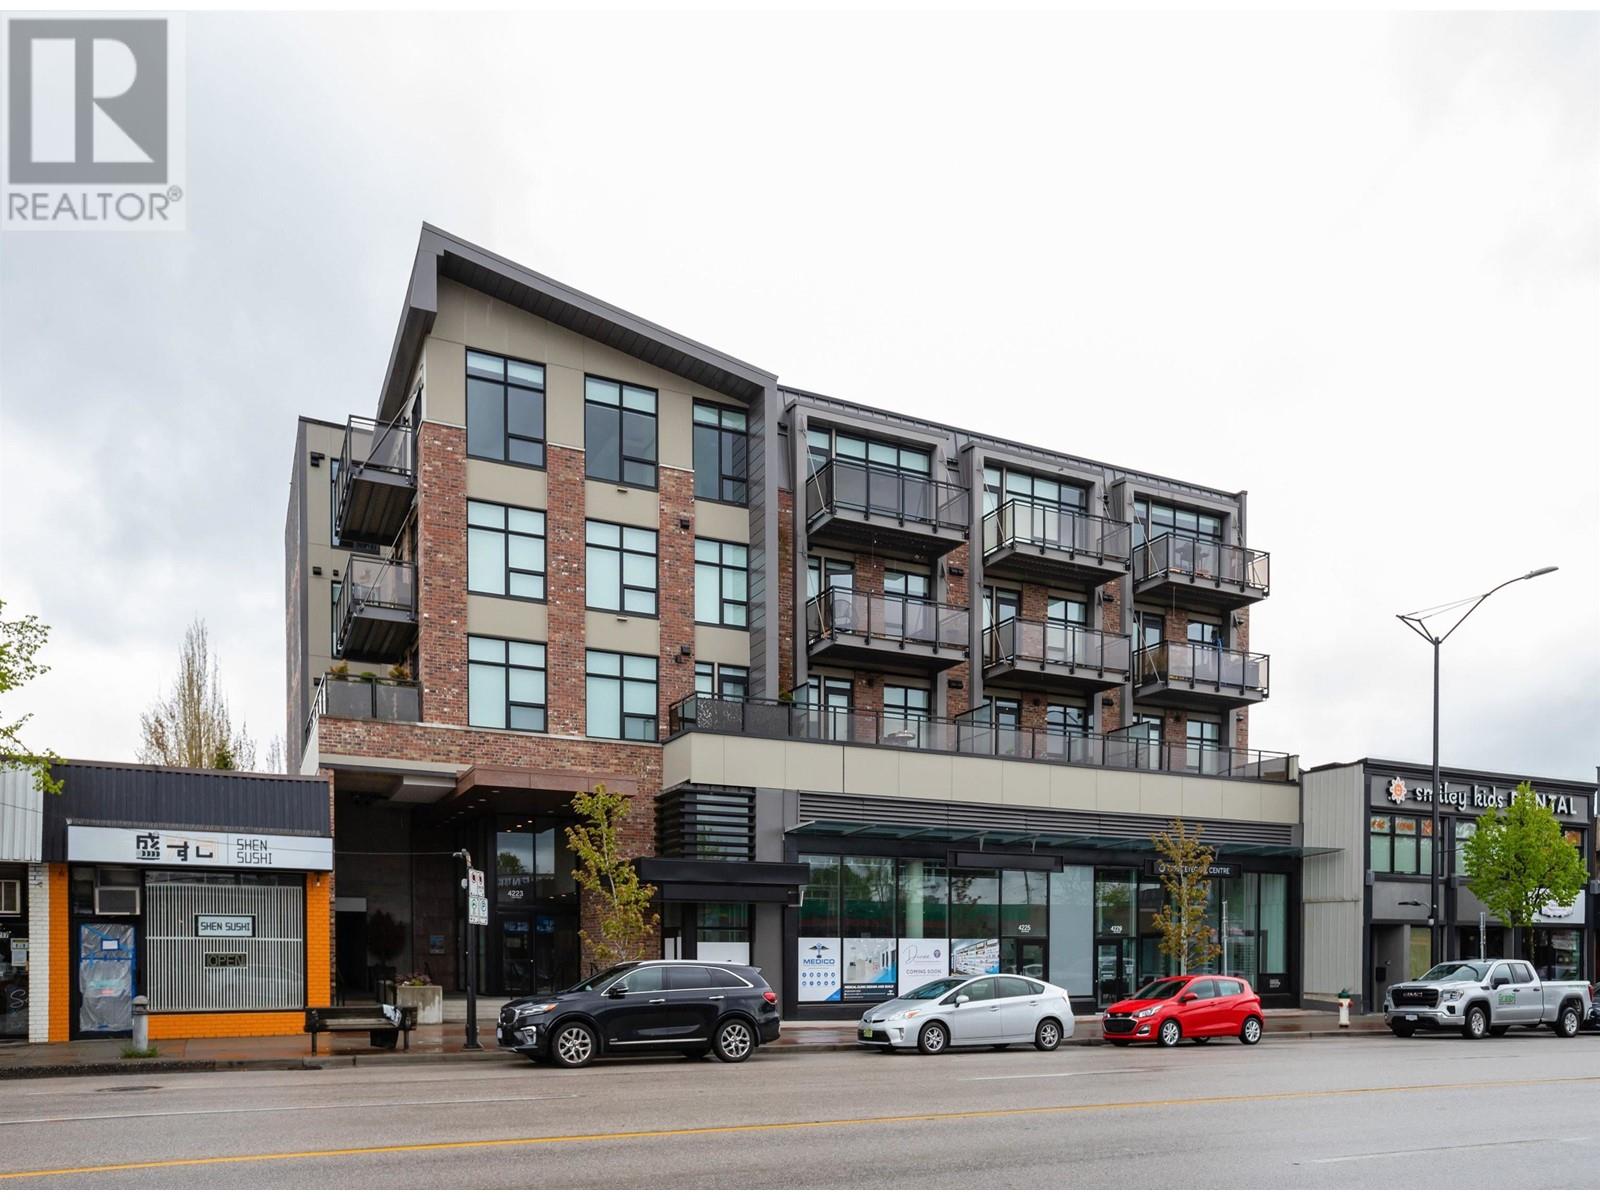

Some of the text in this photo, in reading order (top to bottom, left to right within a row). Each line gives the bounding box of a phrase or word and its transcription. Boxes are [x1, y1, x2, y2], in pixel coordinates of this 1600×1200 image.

[1416, 781, 1577, 815] smiley kids DNTAL
[236, 838, 268, 851] SHEN
[236, 852, 272, 864] SUSHI
[1208, 866, 1230, 875] CENTRE
[200, 921, 250, 931] SHEN SUSHI
[208, 955, 245, 967] OPEN
